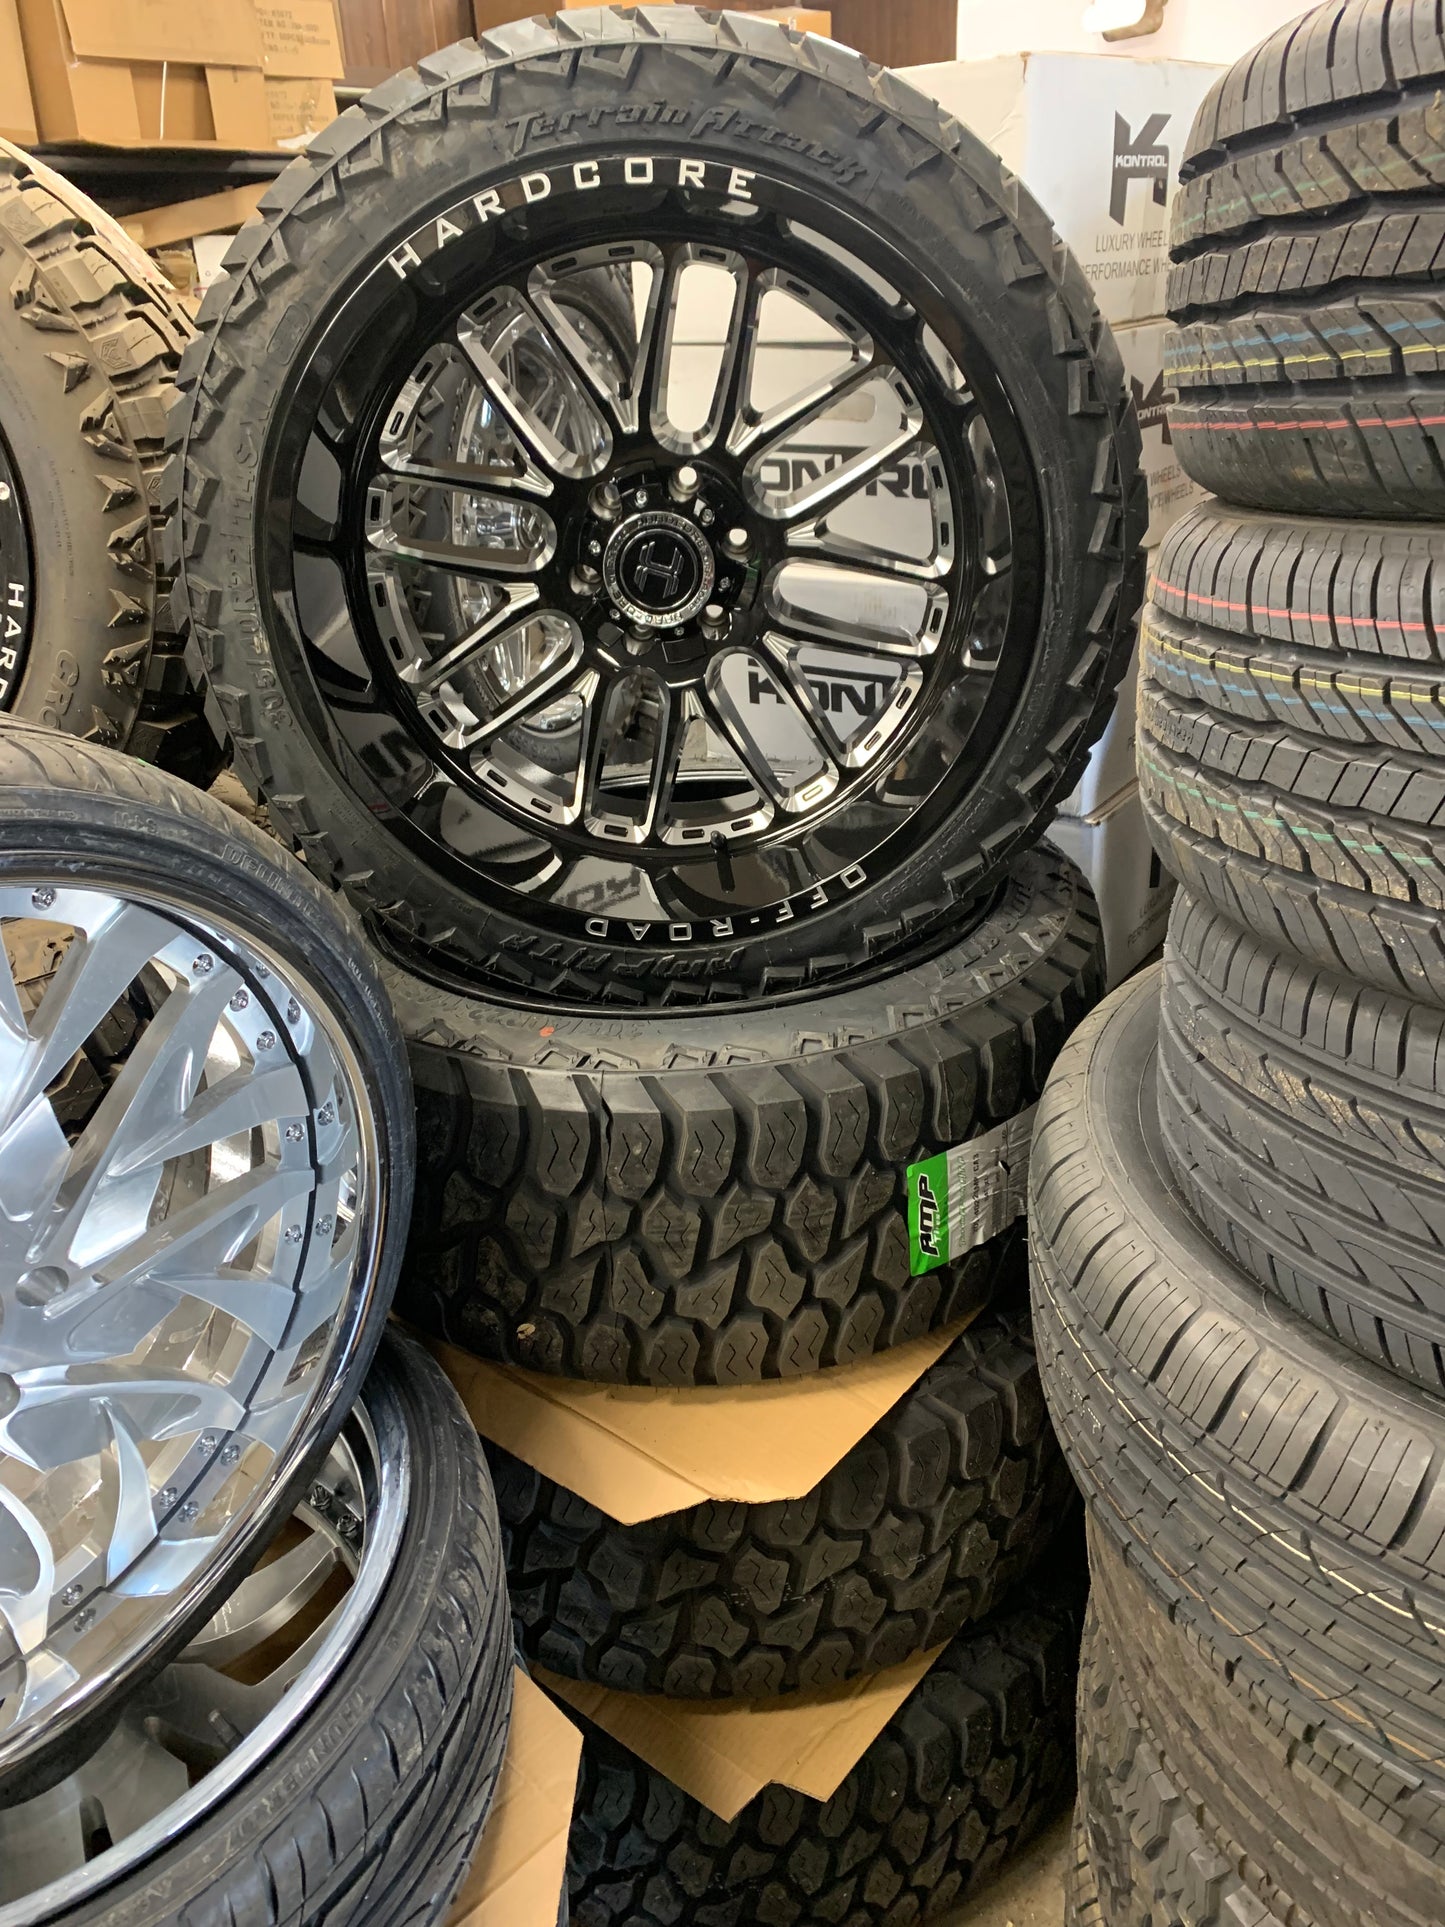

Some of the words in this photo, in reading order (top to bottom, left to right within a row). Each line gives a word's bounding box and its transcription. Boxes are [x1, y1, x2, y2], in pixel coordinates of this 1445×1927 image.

[504, 100, 689, 156] Terrain
[688, 105, 869, 188] Attack
[1114, 154, 1168, 168] KONTROL
[387, 156, 757, 280] HARDCORE
[1096, 232, 1136, 253] LUXURY
[585, 864, 867, 942] OFF-ROAD
[918, 1173, 940, 1258] AMP
